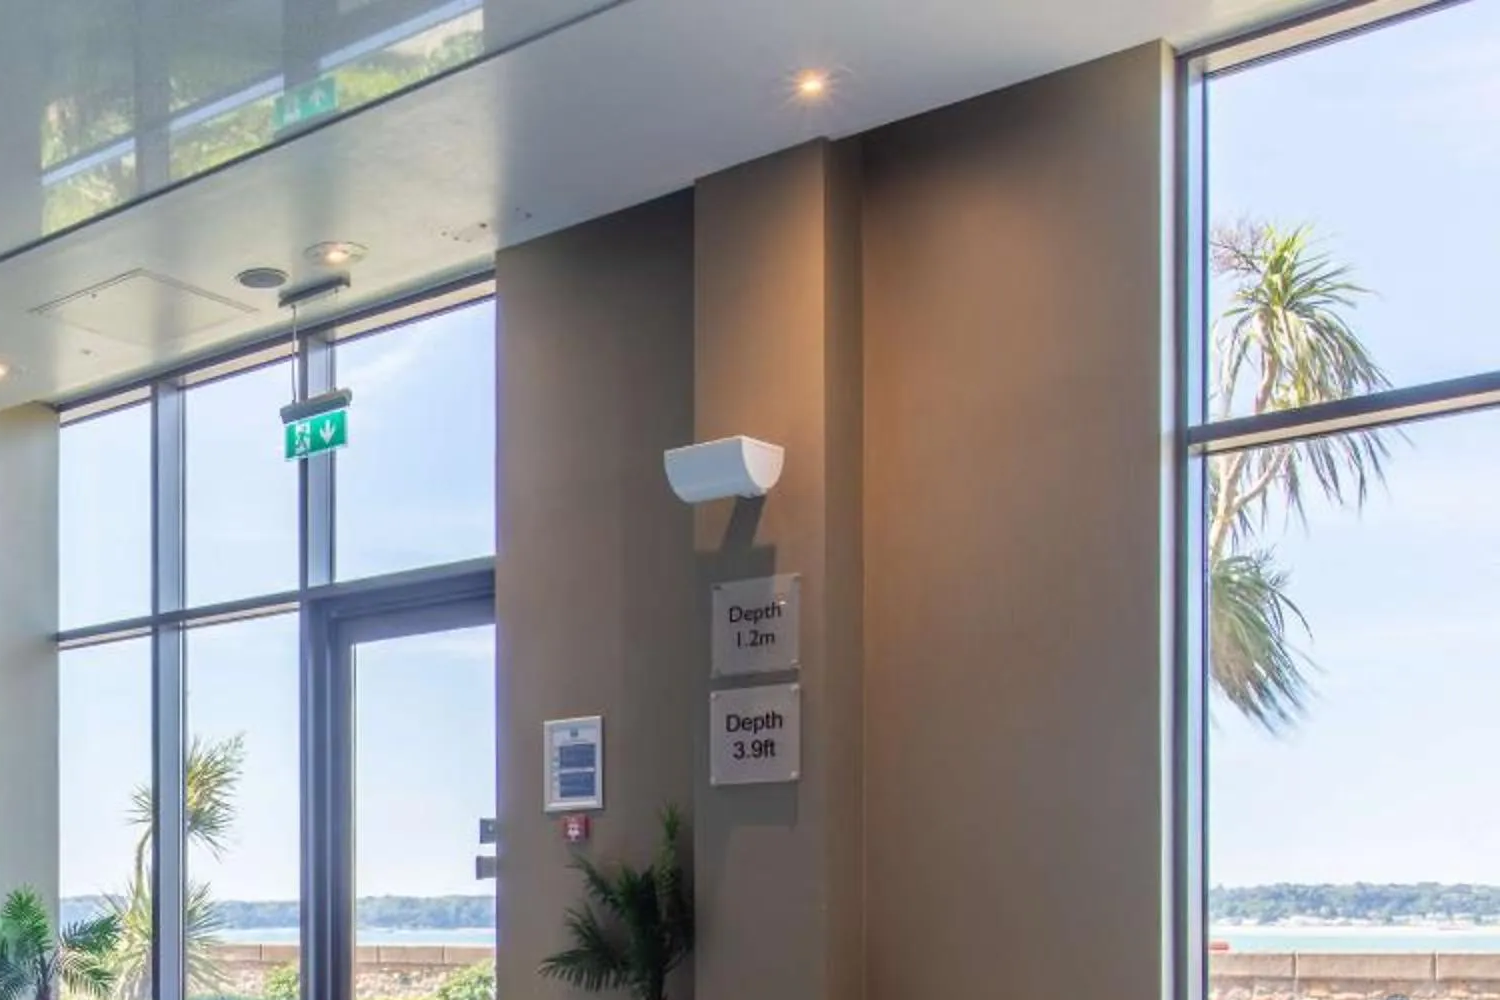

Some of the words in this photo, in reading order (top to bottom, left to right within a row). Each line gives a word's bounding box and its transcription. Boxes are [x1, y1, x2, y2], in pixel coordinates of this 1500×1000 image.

[728, 602, 782, 624] Depth
[736, 629, 775, 648] 1.2m
[725, 710, 783, 735] Depth
[732, 738, 776, 760] 3.9ft
